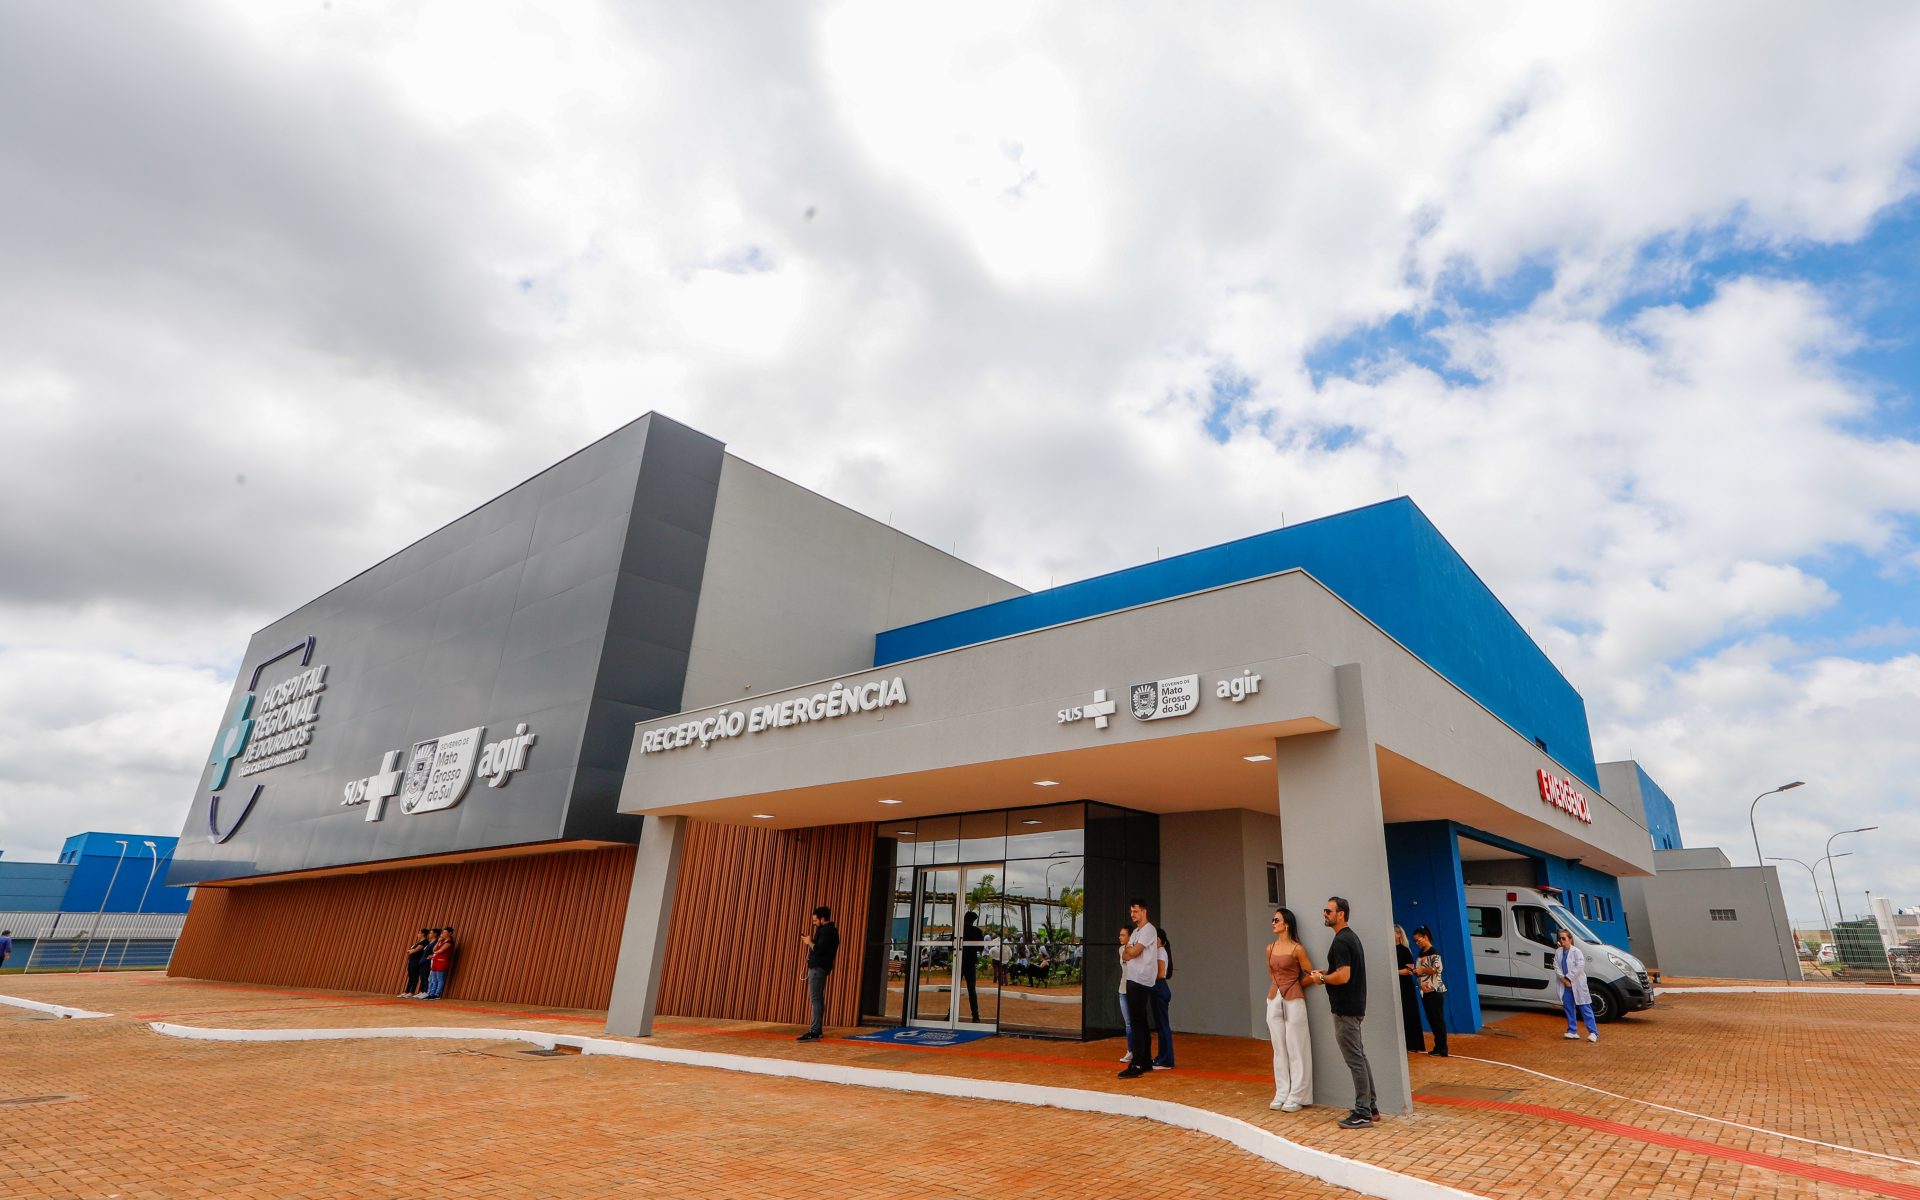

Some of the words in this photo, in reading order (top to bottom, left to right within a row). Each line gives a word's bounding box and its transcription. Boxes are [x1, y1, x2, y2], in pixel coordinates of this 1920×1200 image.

[260, 664, 327, 714] HOSPITAL
[1161, 687, 1183, 696] Mato
[1217, 669, 1262, 702] agir
[1161, 695, 1191, 704] Grosso
[1162, 705, 1173, 713] do
[1174, 702, 1187, 712] Sul
[250, 694, 321, 742] REGIONAL
[640, 708, 745, 754] RECEPÇÃO
[748, 677, 907, 733] EMERGÊNCIA
[1058, 707, 1083, 724] SUS
[242, 742, 259, 764] DE
[254, 725, 312, 760] DOURADOS
[477, 723, 536, 788] agir
[436, 750, 459, 768] Mato
[432, 767, 462, 786] Grosso
[341, 778, 368, 806] SUS
[427, 789, 439, 802] do
[437, 783, 454, 801] Sul
